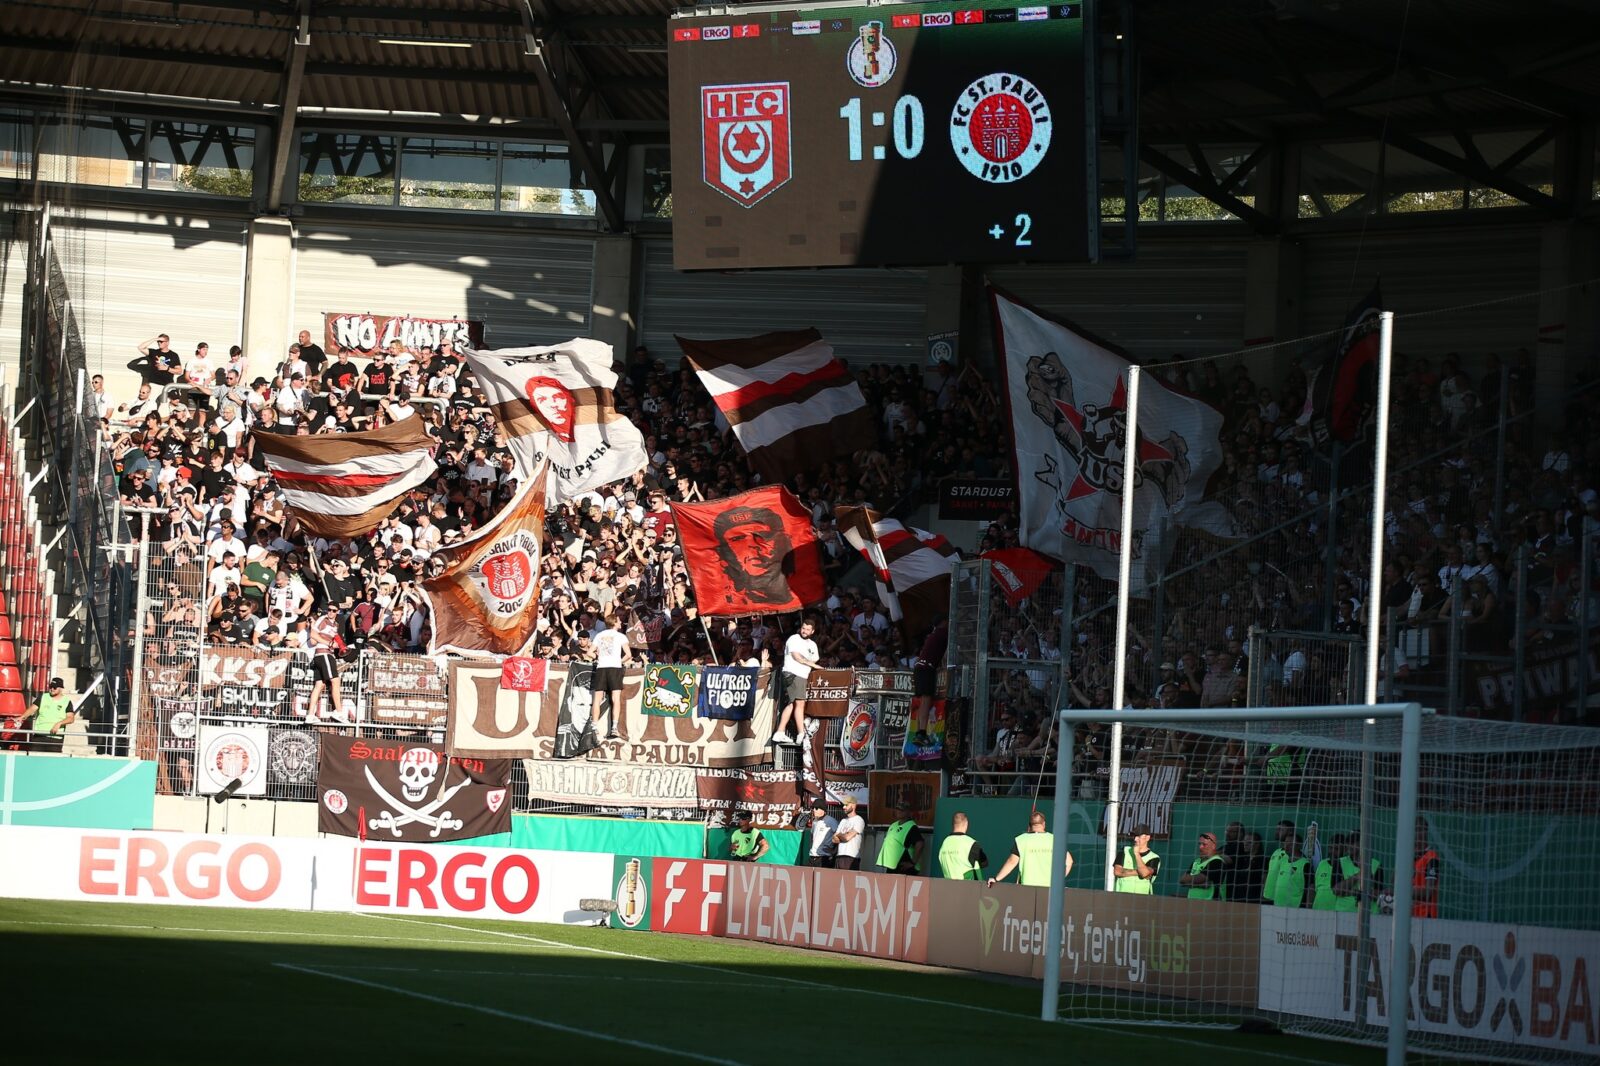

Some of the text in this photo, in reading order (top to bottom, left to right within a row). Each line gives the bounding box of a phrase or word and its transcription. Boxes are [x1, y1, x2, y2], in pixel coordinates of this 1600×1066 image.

[704, 27, 729, 38] ERGO
[924, 14, 950, 24] ERGO
[710, 91, 779, 118] HFC
[953, 75, 1049, 127] FC ST. PAULI
[839, 94, 925, 161] 1:0
[981, 162, 1023, 181] 1910
[1015, 213, 1032, 246] 2
[336, 315, 377, 350] NO
[574, 440, 611, 477] PAULI
[950, 486, 1012, 497] STARDUST
[706, 673, 752, 690] ULTRAS
[180, 702, 206, 712] PAUI
[630, 743, 705, 766] PAULI
[532, 763, 609, 796] ENFANTS
[768, 803, 797, 812] PAULI
[78, 835, 282, 902] ERGO
[354, 847, 541, 915] ERGO
[700, 863, 898, 956] FLYERALARM
[1083, 913, 1146, 983] fertig,
[1151, 919, 1191, 974] los!
